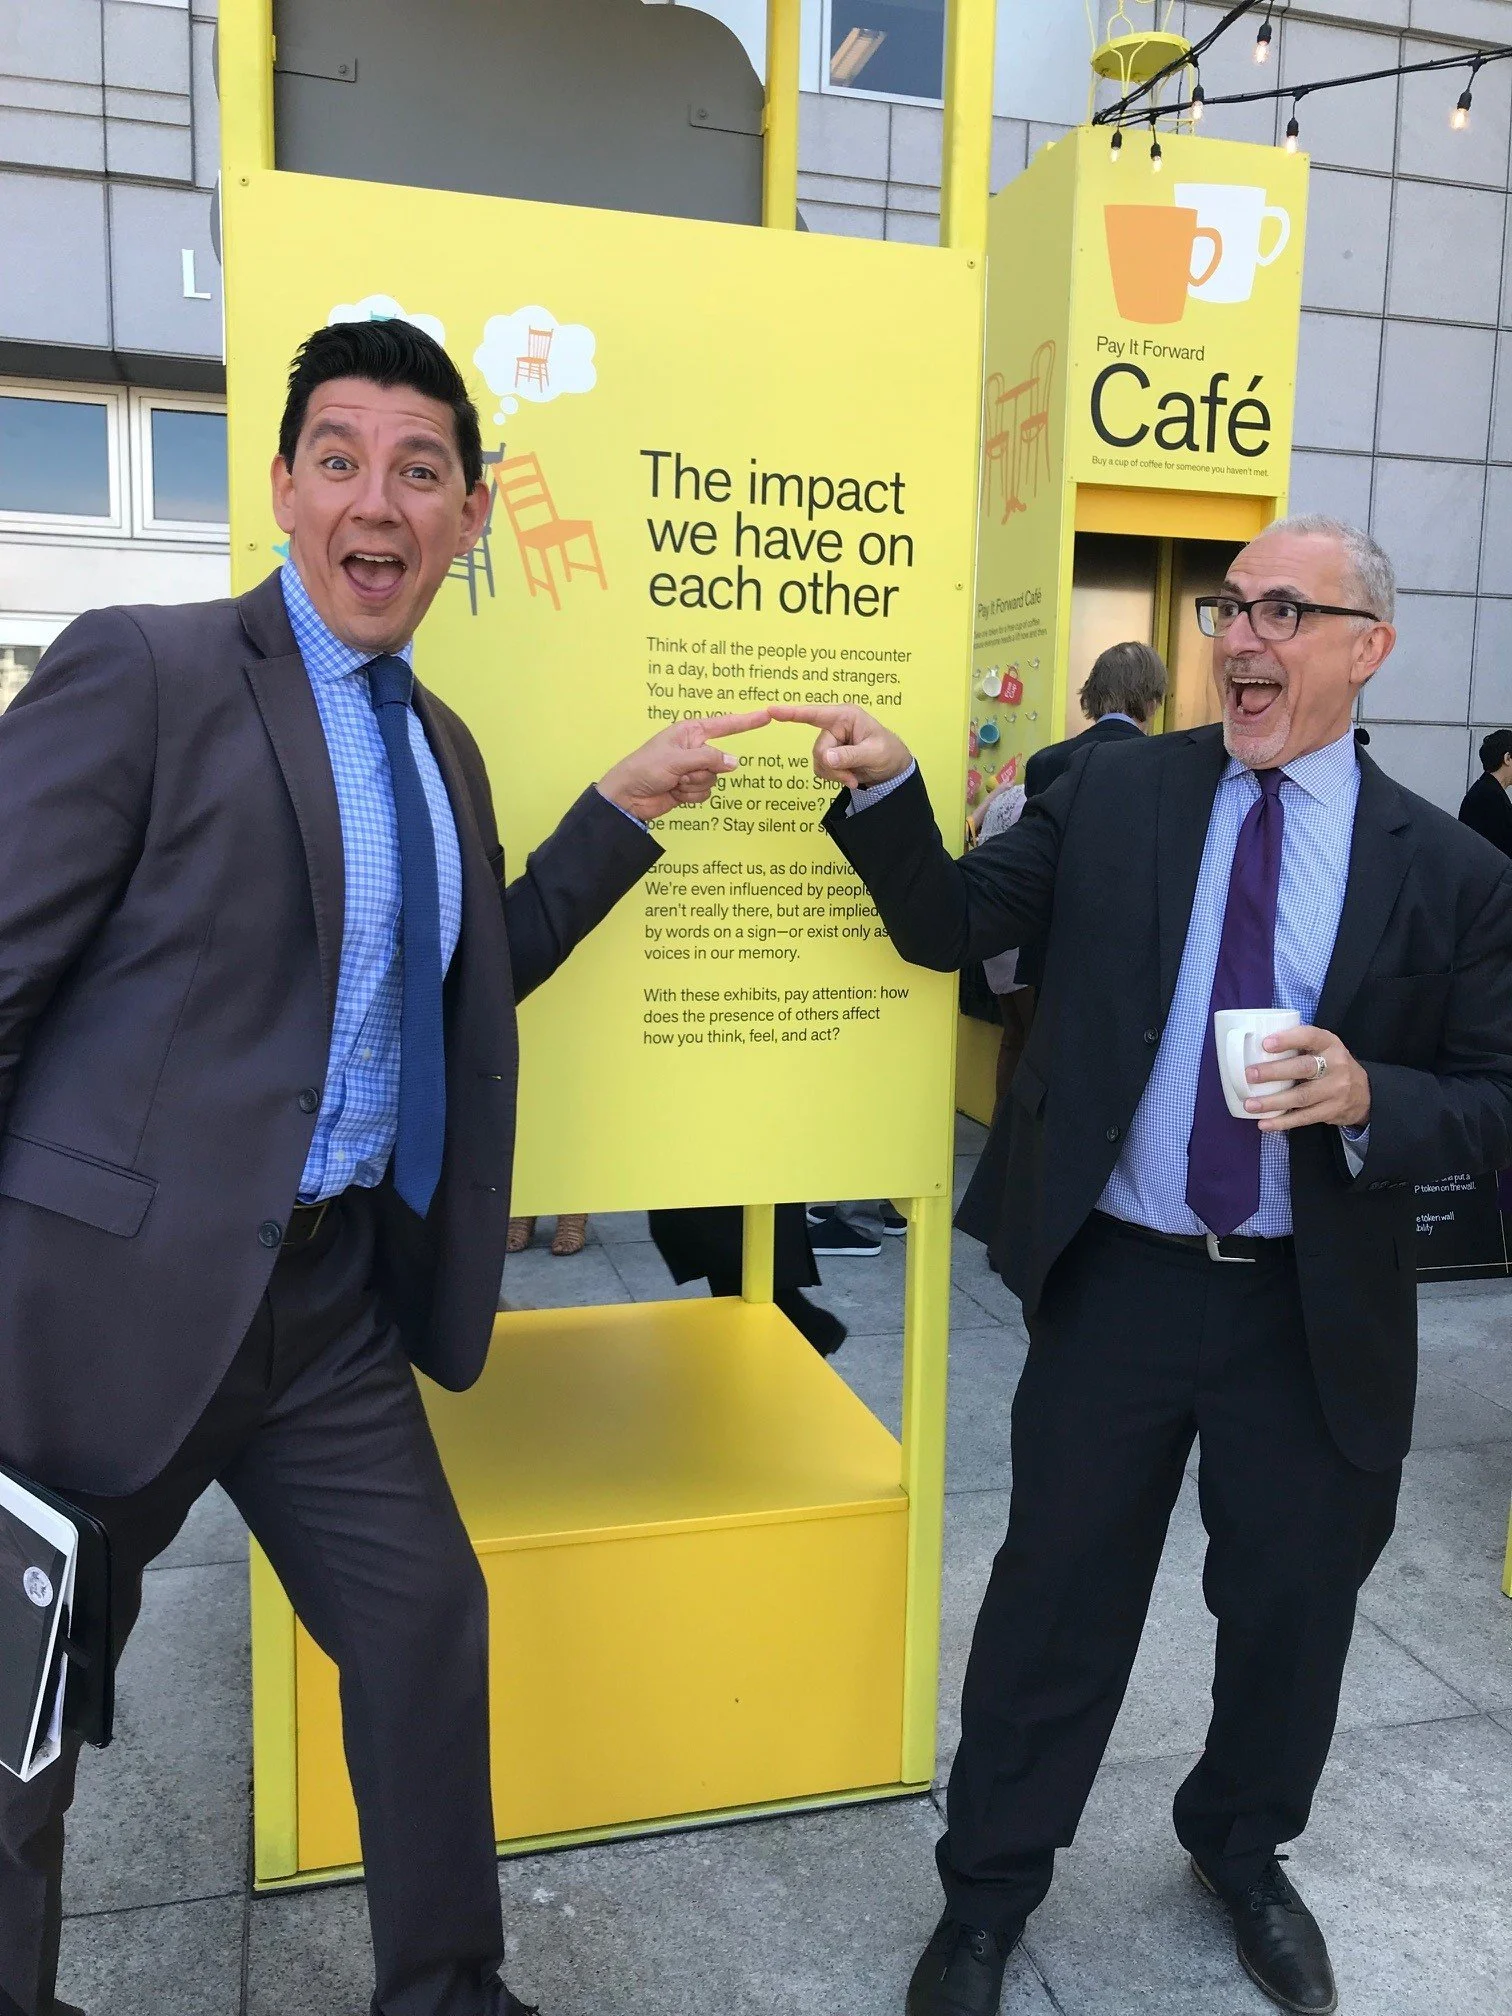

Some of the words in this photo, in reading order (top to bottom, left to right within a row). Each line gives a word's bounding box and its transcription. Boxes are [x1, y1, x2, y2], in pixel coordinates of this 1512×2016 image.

[181, 248, 212, 300] L
[1096, 335, 1126, 358] Pay
[1129, 338, 1140, 356] It
[1142, 340, 1205, 362] Forward
[1090, 362, 1271, 458] Café
[1092, 456, 1106, 467] Buy
[1115, 459, 1129, 468] cup
[1131, 458, 1138, 467] of
[1140, 459, 1163, 469] coffee
[1165, 460, 1174, 470] for
[1176, 463, 1210, 472] someone
[1211, 465, 1225, 475] you
[1226, 466, 1252, 476] haven't
[1254, 468, 1270, 477] met.
[640, 449, 732, 503] The
[750, 458, 906, 521] impact
[646, 518, 717, 556] we
[735, 510, 843, 563] have
[859, 532, 914, 567] on
[649, 565, 762, 611] each
[779, 570, 899, 617] other
[996, 592, 1023, 613] Forward
[646, 637, 688, 654] Think
[691, 639, 707, 655] of
[710, 640, 726, 656] all
[730, 641, 754, 657] the
[757, 644, 807, 662] people
[811, 647, 836, 663] you
[840, 648, 912, 663] encounter
[648, 660, 662, 675] in
[665, 664, 674, 675] a
[678, 662, 708, 680] day,
[712, 663, 745, 679] both
[749, 664, 799, 681] friends
[802, 667, 828, 682] and
[832, 669, 901, 687] strangers.
[646, 682, 674, 698] You
[678, 683, 713, 700] have
[716, 688, 734, 700] an
[738, 686, 779, 702] effect
[783, 692, 801, 704] on
[805, 690, 839, 705] each
[842, 693, 873, 707] one,
[876, 691, 902, 706] and
[647, 705, 679, 723] they
[683, 709, 702, 721] on
[738, 756, 755, 767] or
[757, 753, 785, 769] not,
[788, 756, 808, 768] we
[730, 774, 765, 790] what
[769, 775, 783, 790] to
[786, 775, 809, 790] do:
[710, 795, 743, 810] Give
[746, 799, 762, 811] or
[765, 797, 826, 812] receive?
[669, 817, 719, 832] mean?
[723, 817, 755, 836] Stay
[758, 818, 796, 833] silent
[799, 820, 814, 833] or
[703, 859, 744, 875] affect
[747, 863, 767, 877] us,
[769, 864, 786, 876] as
[789, 860, 808, 876] do
[645, 881, 687, 896] We're
[691, 885, 725, 896] even
[729, 881, 803, 897] influenced
[807, 882, 824, 899] by
[645, 903, 687, 918] aren't
[690, 903, 729, 921] really
[732, 902, 773, 919] there,
[776, 902, 799, 918] but
[803, 906, 825, 918] are
[828, 902, 879, 921] implied
[645, 924, 662, 942] by
[666, 924, 710, 939] words
[713, 927, 732, 939] on
[735, 927, 744, 939] a
[807, 924, 838, 939] exist
[842, 924, 871, 942] only
[874, 927, 890, 939] as
[644, 946, 690, 960] voices
[694, 946, 707, 960] in
[710, 948, 735, 960] our
[738, 948, 801, 965] memory.
[643, 987, 676, 1003] With
[680, 987, 720, 1002] these
[723, 987, 780, 1003] exhibits,
[784, 990, 809, 1006] pay
[812, 985, 877, 1001] attention:
[880, 985, 909, 1000] how
[643, 1009, 678, 1024] does
[682, 1008, 706, 1023] the
[709, 1010, 775, 1027] presence
[778, 1007, 793, 1022] of
[795, 1006, 839, 1021] others
[842, 1005, 881, 1020] affect
[643, 1030, 674, 1045] how
[677, 1033, 704, 1048] you
[707, 1029, 746, 1045] think,
[749, 1028, 777, 1044] feel,
[781, 1027, 808, 1042] and
[811, 1025, 840, 1041] act?
[1421, 1184, 1440, 1193] token
[1450, 1182, 1460, 1192] the
[1454, 1173, 1465, 1183] put
[1421, 1213, 1440, 1222] token
[1441, 1210, 1455, 1221] wall
